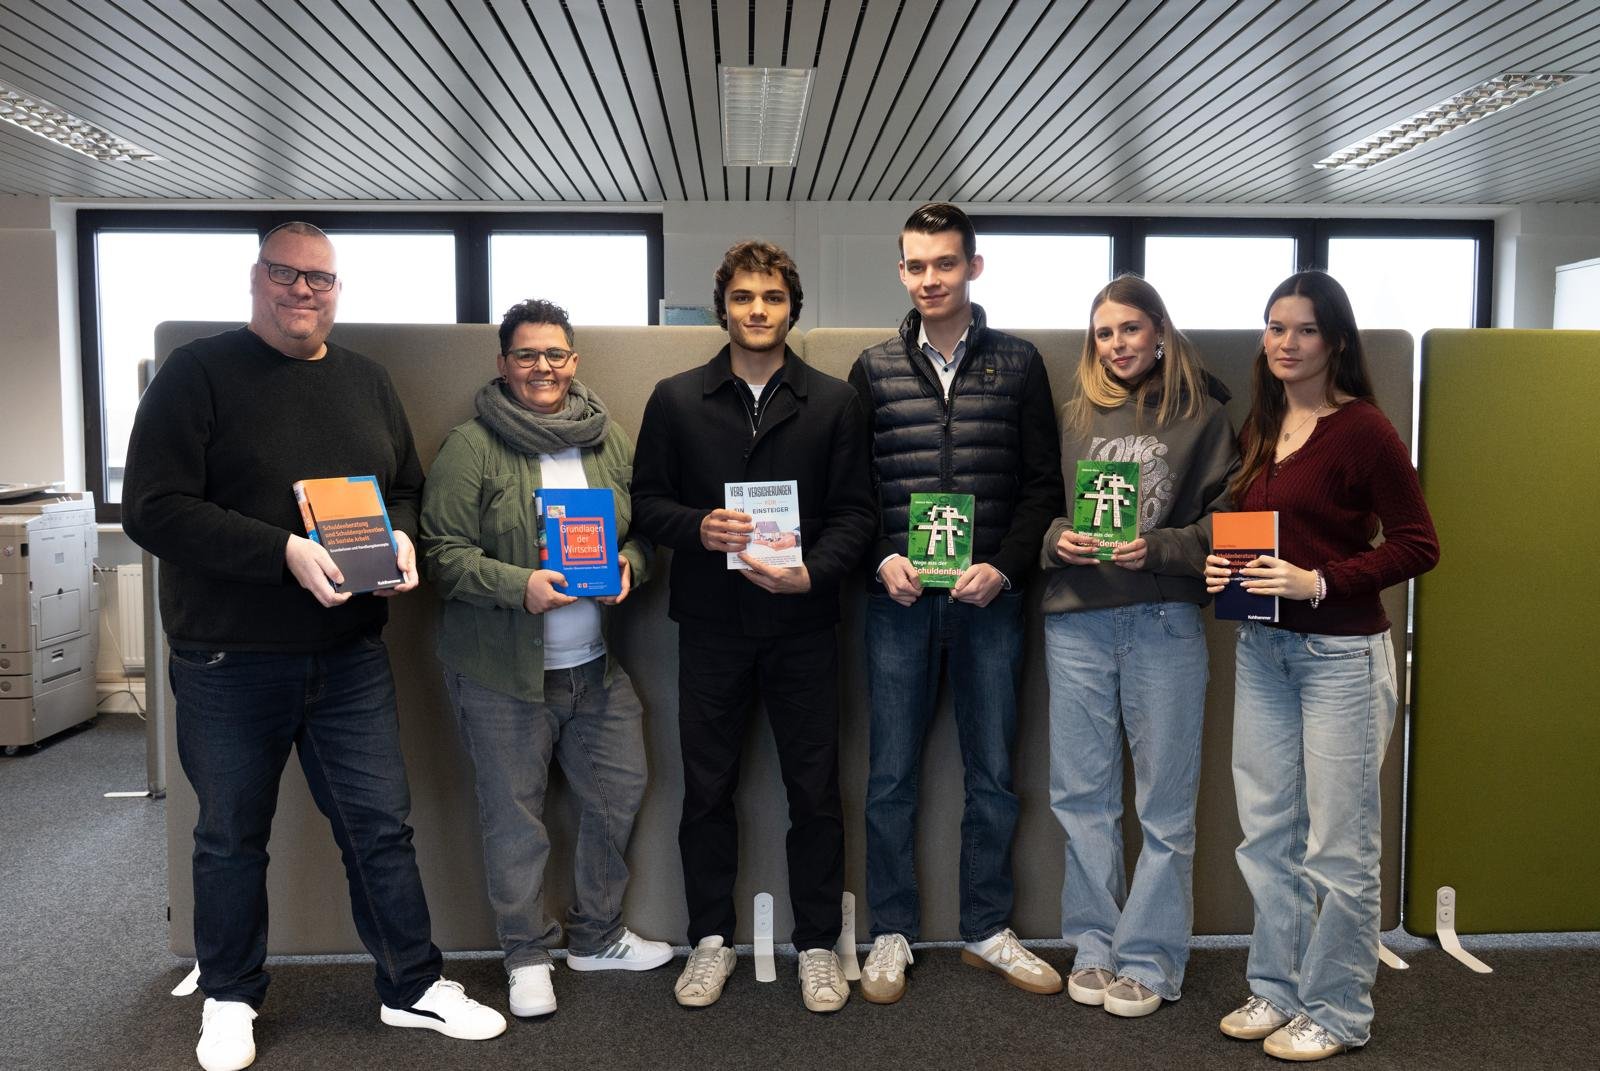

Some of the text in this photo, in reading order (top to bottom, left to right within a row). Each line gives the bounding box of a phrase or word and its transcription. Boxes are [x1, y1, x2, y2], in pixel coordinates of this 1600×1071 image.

[748, 485, 792, 498] VERSICHERUNGEN
[560, 524, 604, 535] Grundlagen
[563, 545, 604, 554] Wirtschaft
